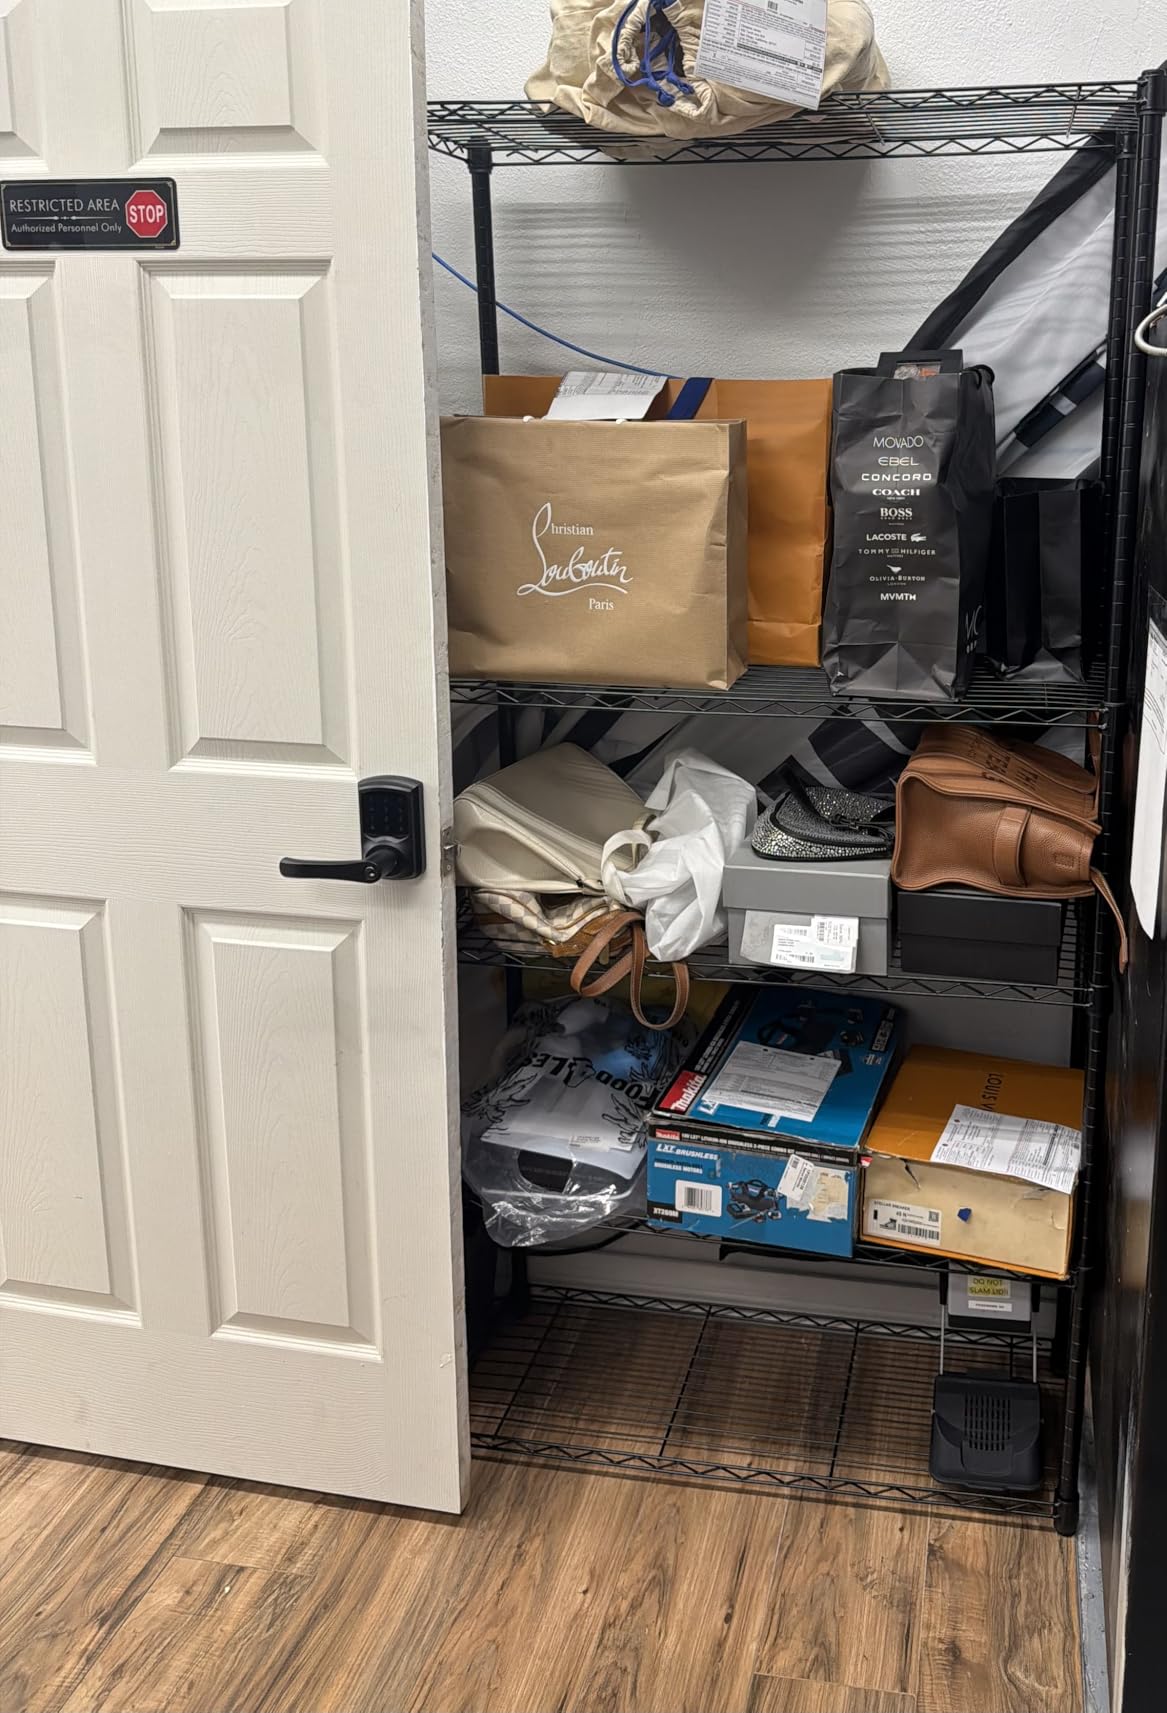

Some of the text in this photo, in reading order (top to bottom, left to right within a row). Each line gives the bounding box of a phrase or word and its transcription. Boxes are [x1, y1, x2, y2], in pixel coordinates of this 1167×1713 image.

[10, 198, 120, 213] RESTRICTED AREA
[129, 204, 164, 224] STOP
[11, 222, 122, 233] Authorized Personnel Only
[873, 435, 924, 449] MOVADO
[878, 456, 920, 466] EBEL
[861, 473, 932, 481] CONCORD
[872, 488, 921, 496] COACH
[880, 507, 913, 517] BOSS
[866, 533, 907, 541] LACOSTE
[517, 502, 633, 596] Louboutin
[588, 598, 614, 610] Paris
[982, 1073, 1003, 1100] LOUIS
[676, 1148, 719, 1160] BRUSHLESS
[972, 1277, 1003, 1286] DO NOT
